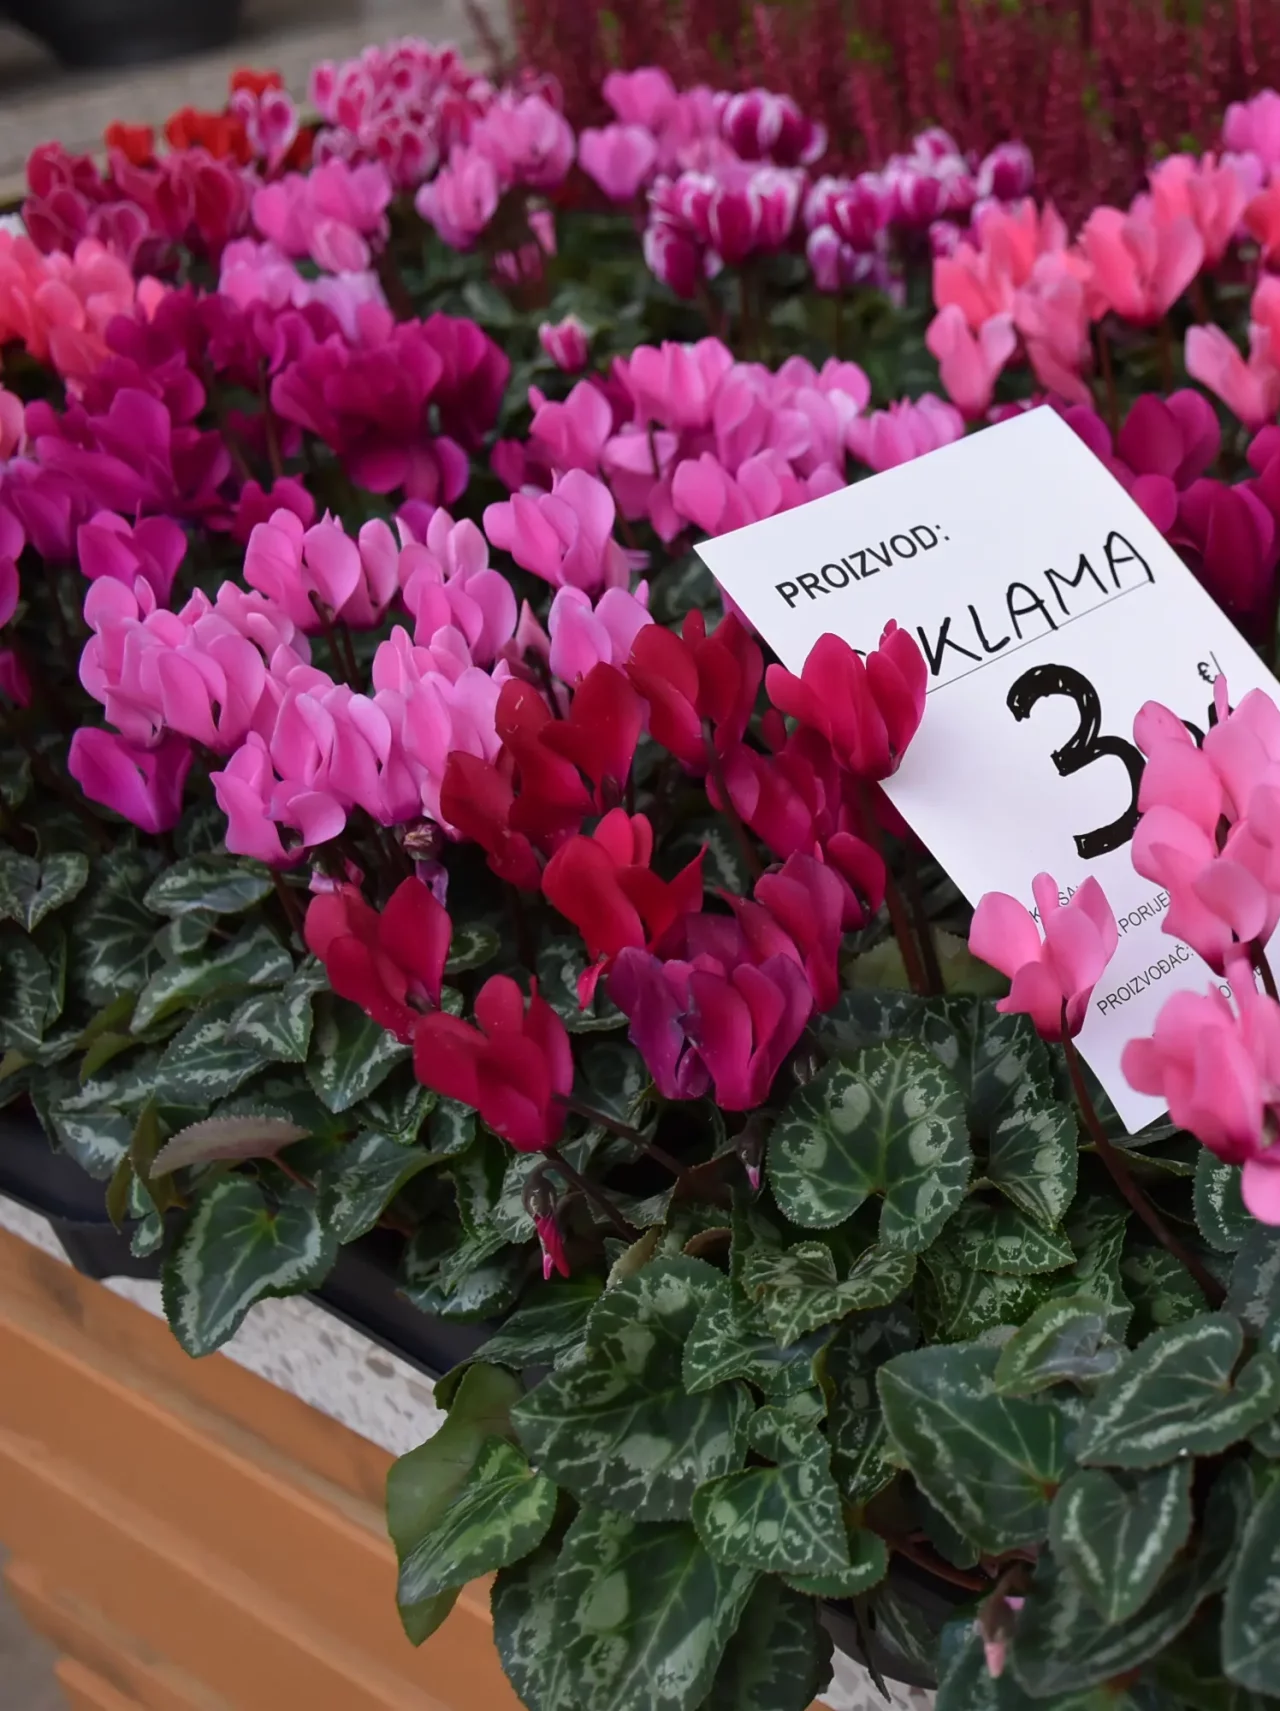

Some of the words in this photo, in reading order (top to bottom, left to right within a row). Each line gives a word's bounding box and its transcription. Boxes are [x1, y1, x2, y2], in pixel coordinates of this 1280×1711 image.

[775, 524, 951, 608] PROIZVOD:
[853, 531, 1155, 676] KLAMA
[1118, 890, 1171, 934] PORIJE
[1096, 943, 1195, 1016] PROIZVOĐAČ:
